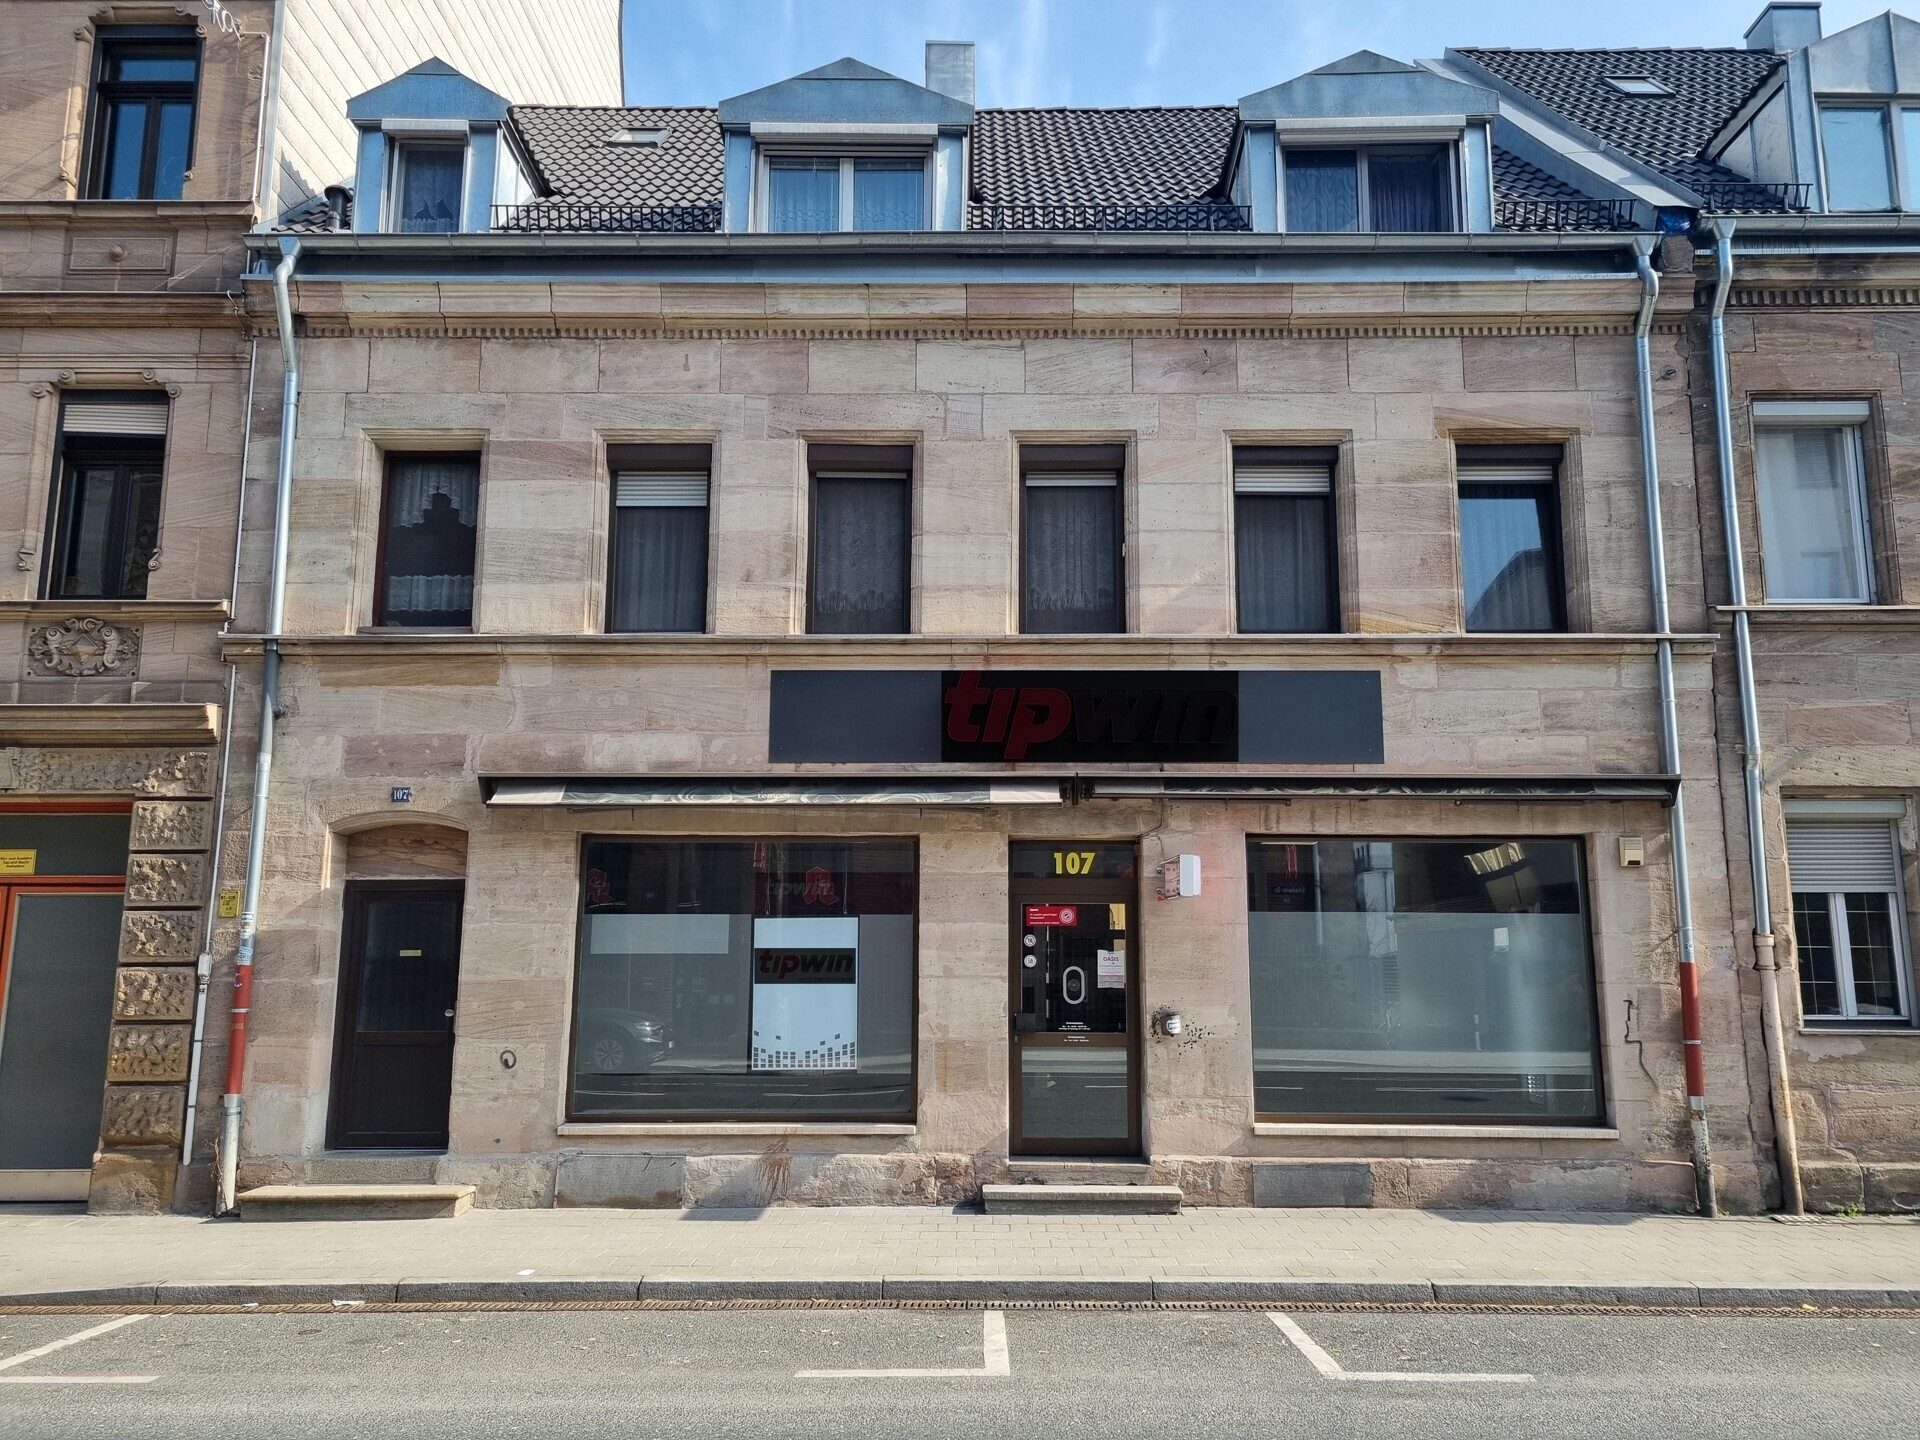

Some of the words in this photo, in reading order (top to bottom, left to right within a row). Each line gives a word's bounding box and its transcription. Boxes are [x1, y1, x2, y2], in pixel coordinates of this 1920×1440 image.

[944, 670, 1237, 761] tipwin
[393, 789, 409, 800] 107
[1053, 852, 1096, 875] 107
[759, 950, 853, 979] tipwin
